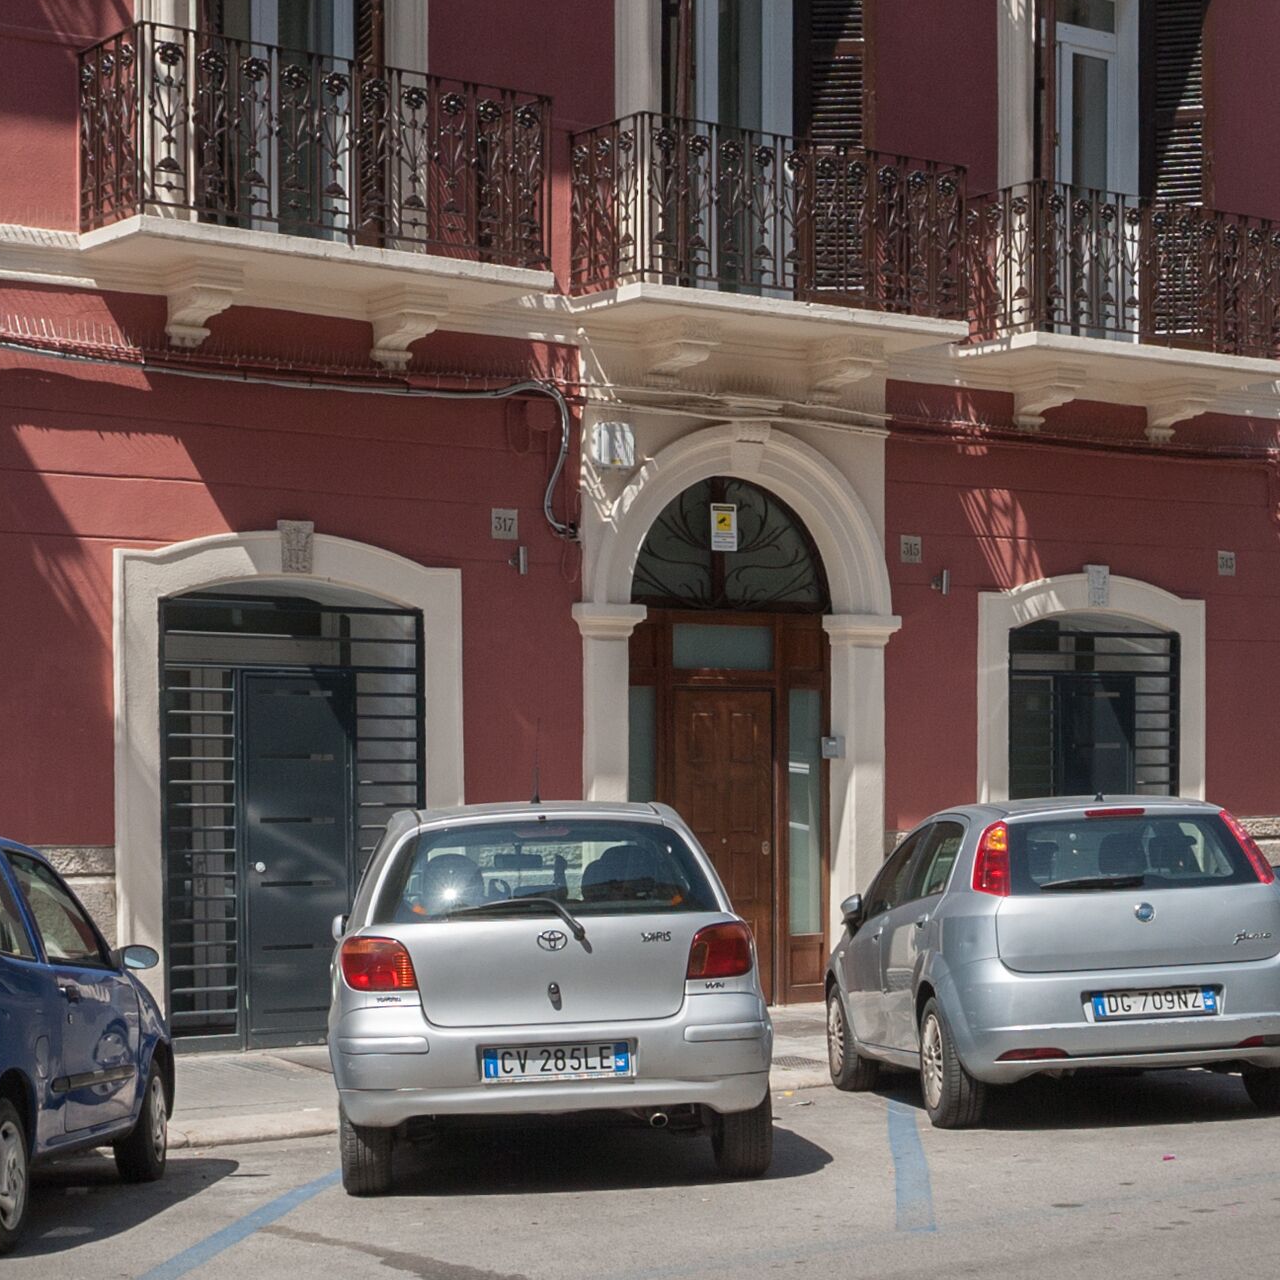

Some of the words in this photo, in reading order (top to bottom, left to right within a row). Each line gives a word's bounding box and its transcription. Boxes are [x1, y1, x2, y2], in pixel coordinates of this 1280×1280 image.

[494, 516, 515, 532] 317
[903, 542, 920, 556] 315
[1106, 994, 1131, 1013] DG
[1138, 989, 1201, 1011] 709NZ
[501, 1050, 528, 1074] CV
[540, 1046, 612, 1072] 285LE
